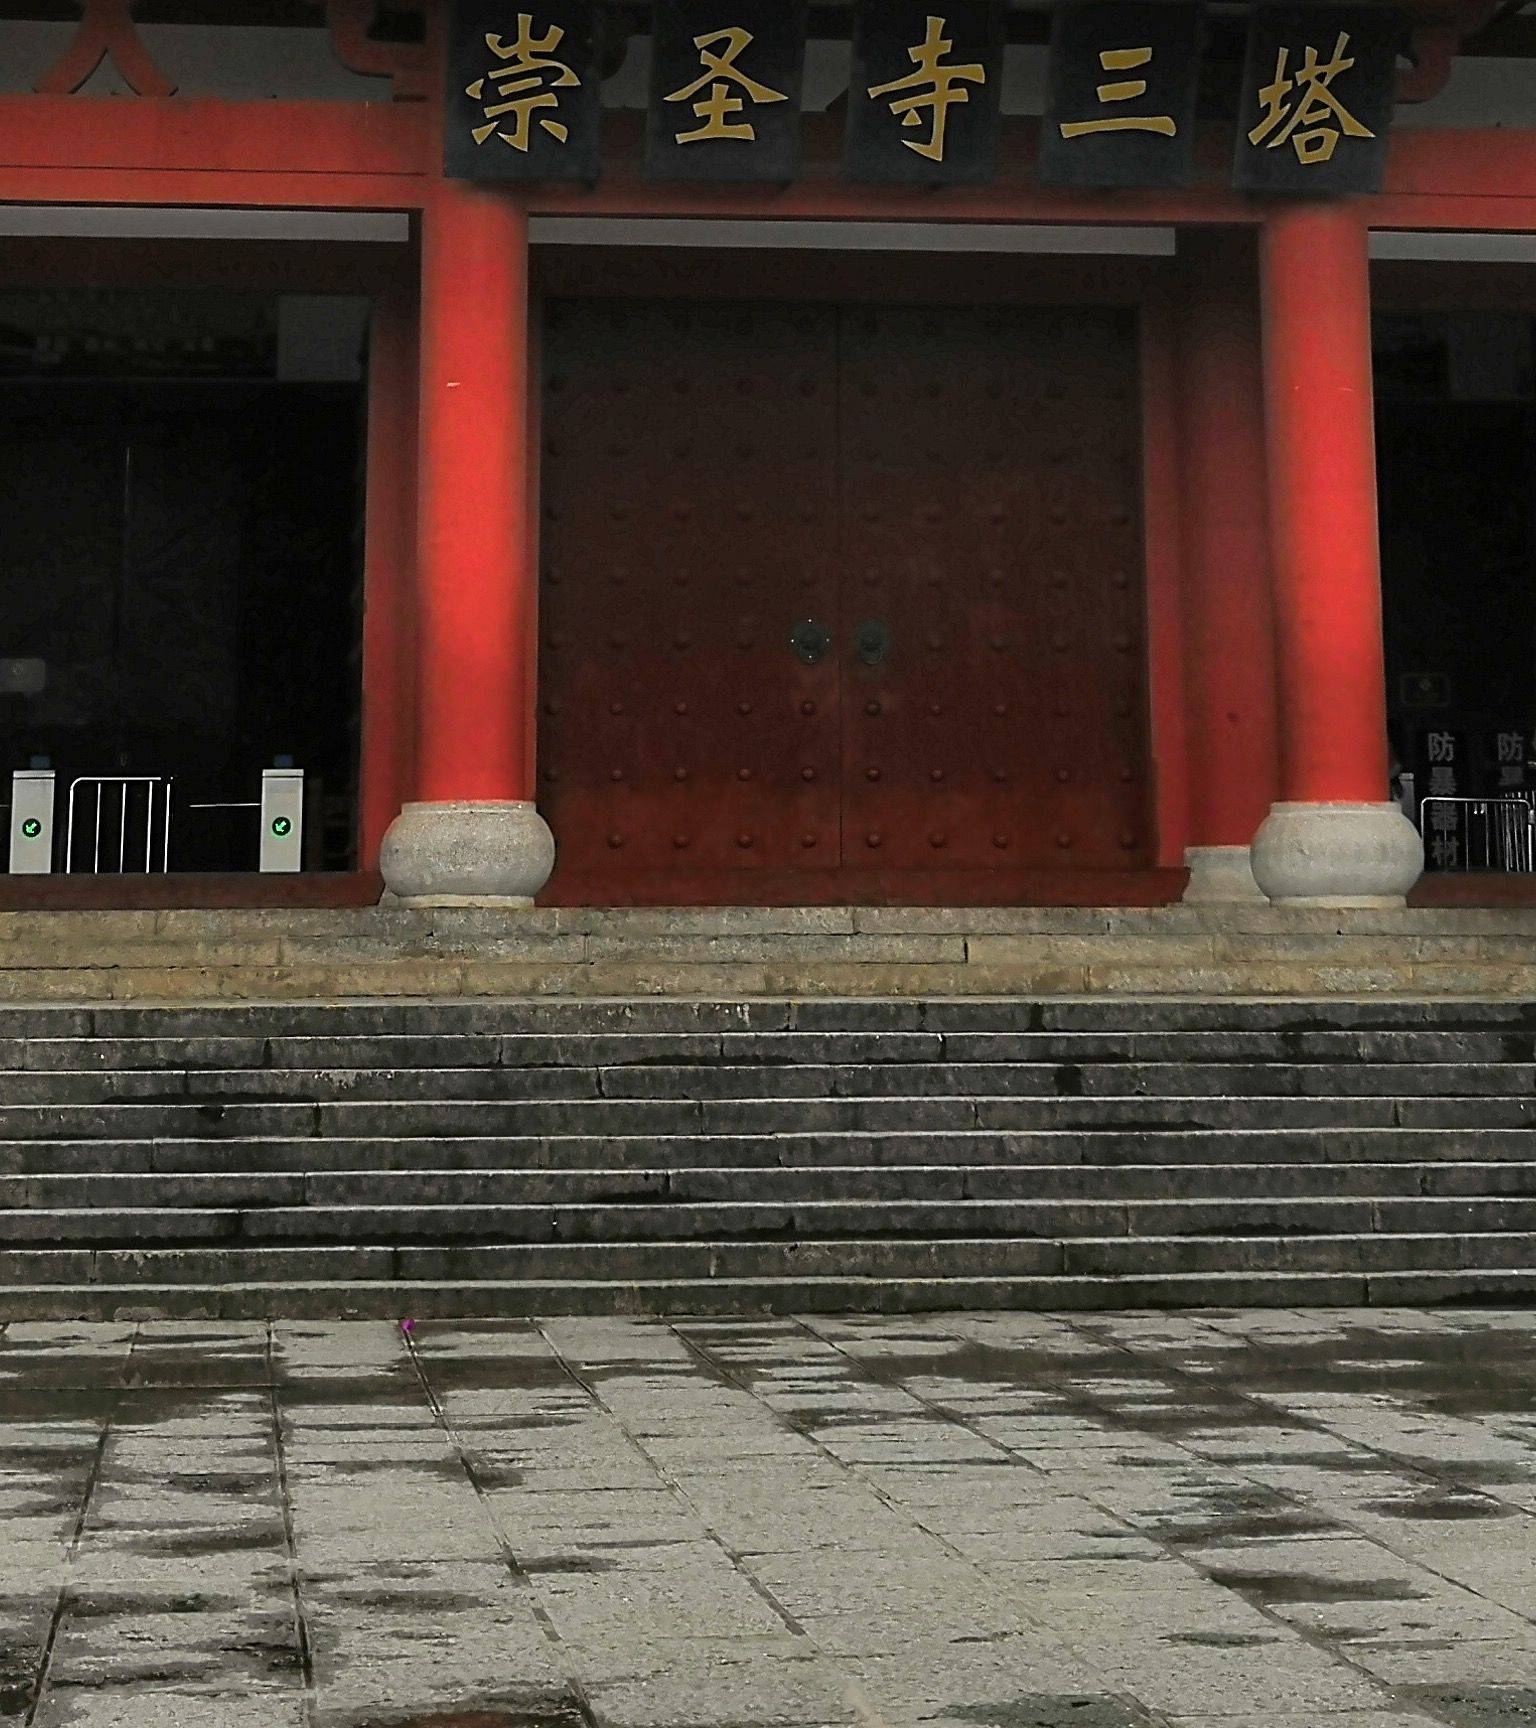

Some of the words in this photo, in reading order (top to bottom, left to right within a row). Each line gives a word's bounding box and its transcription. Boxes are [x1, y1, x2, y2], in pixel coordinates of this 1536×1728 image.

[464, 12, 1376, 165] 崇圣寺三塔
